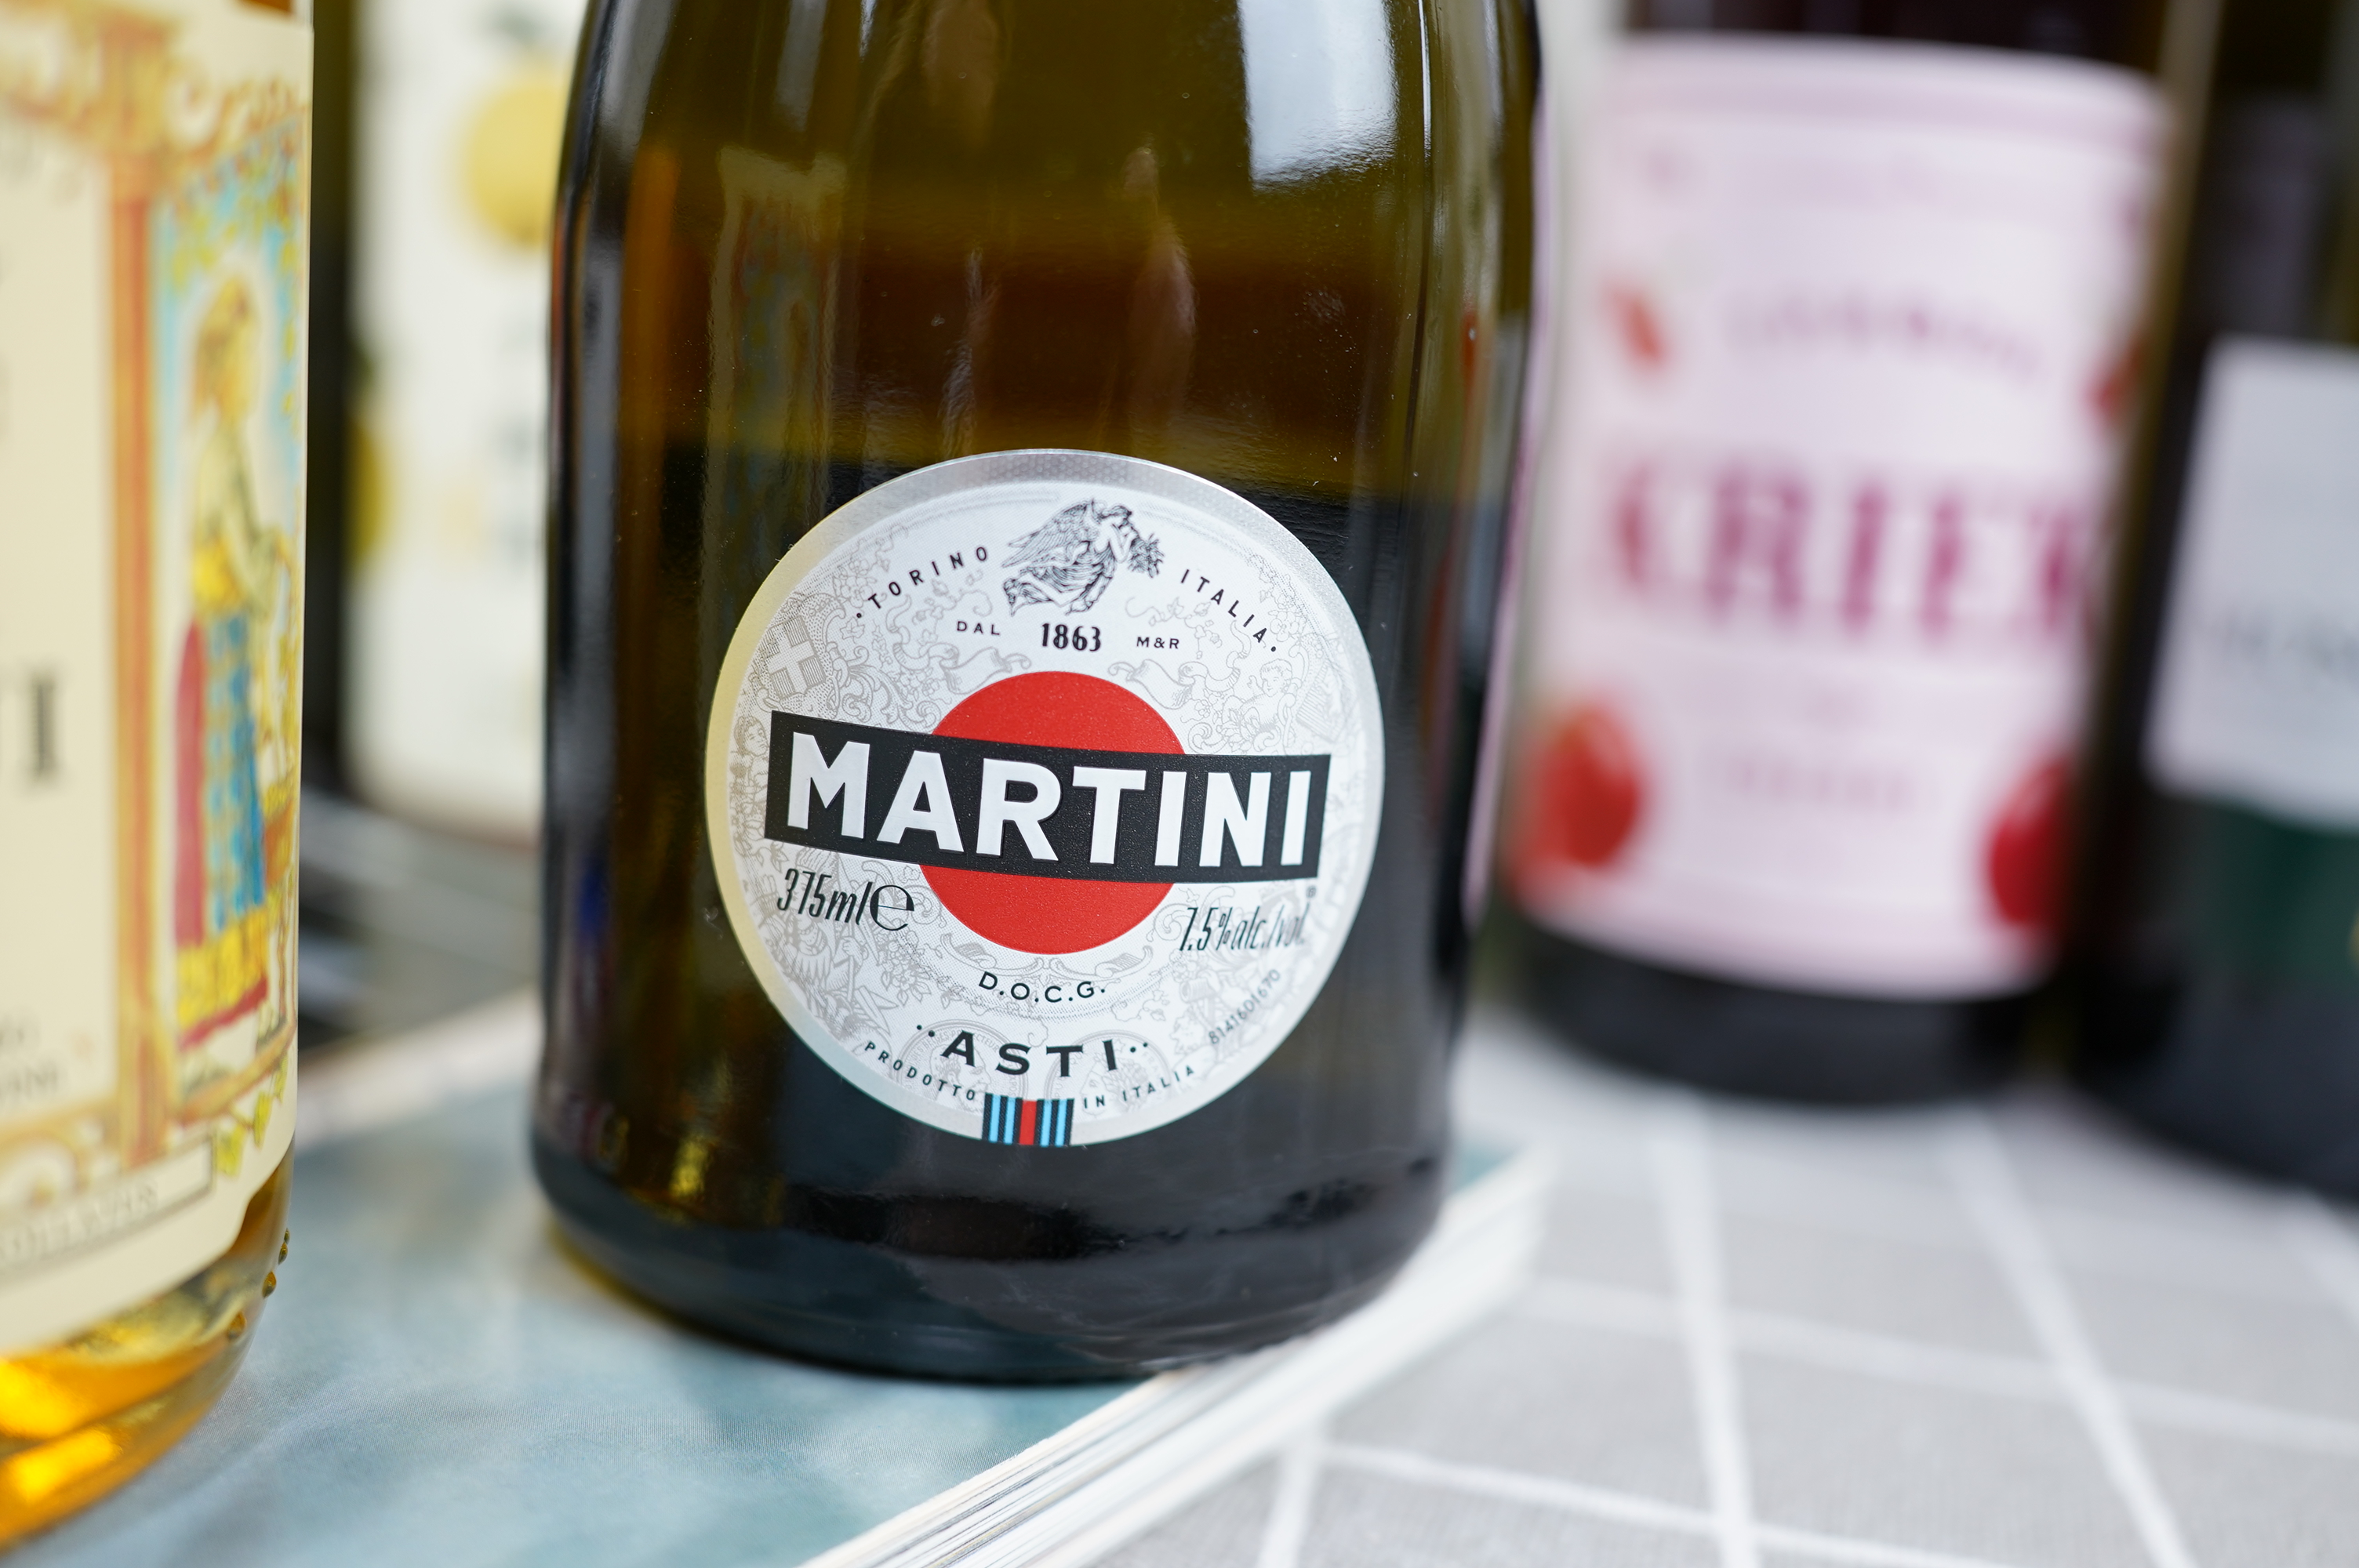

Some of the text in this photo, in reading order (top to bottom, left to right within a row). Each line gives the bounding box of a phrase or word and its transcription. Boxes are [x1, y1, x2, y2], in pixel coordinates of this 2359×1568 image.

[868, 546, 989, 610] TORINO
[1180, 569, 1268, 643] ITALIA
[956, 620, 1180, 653] DAL 1863 M&R
[787, 732, 1312, 869] MARTINI
[979, 971, 1107, 1004] D.O.C.G.
[864, 1040, 976, 1101] PRODOTTO
[1083, 1094, 1105, 1109] IN
[1122, 1065, 1194, 1102] ITALIA
[941, 1029, 1118, 1079] ASTI
